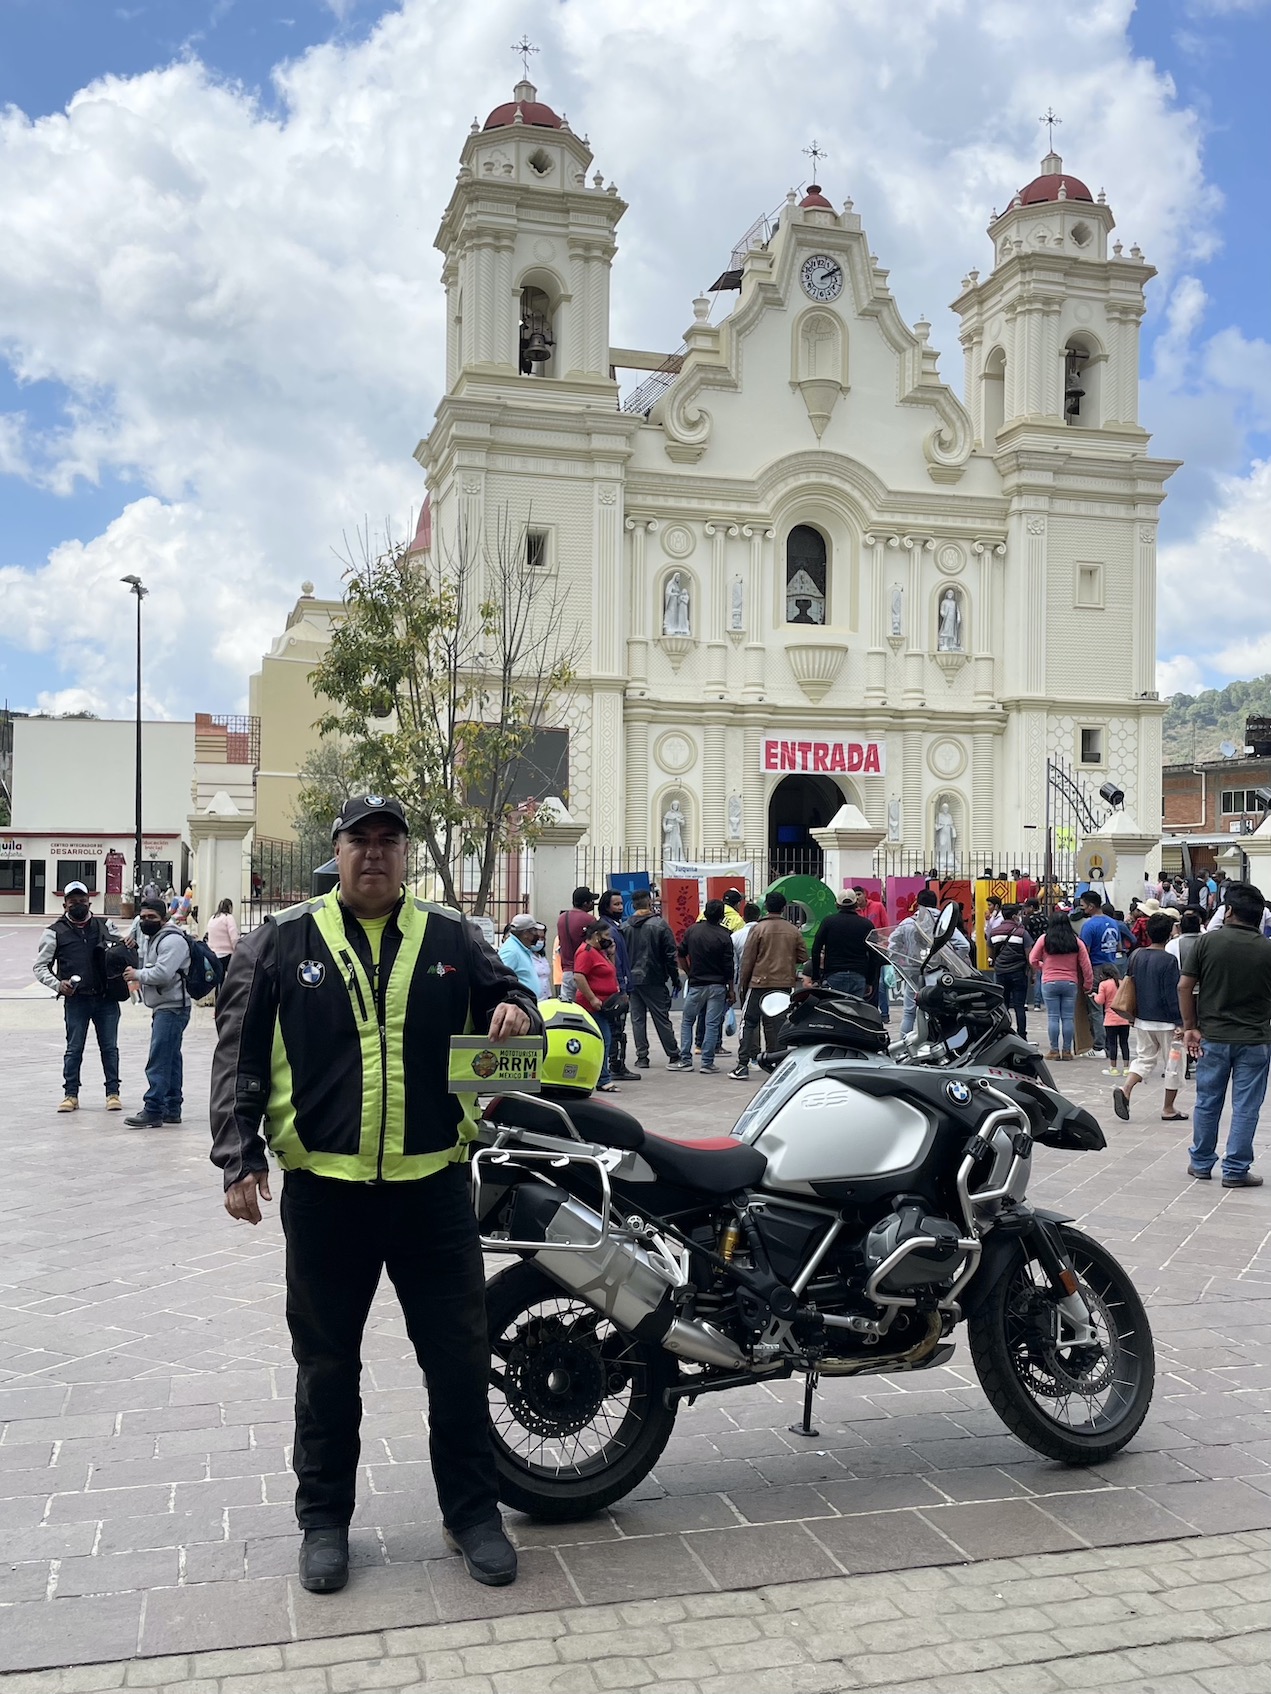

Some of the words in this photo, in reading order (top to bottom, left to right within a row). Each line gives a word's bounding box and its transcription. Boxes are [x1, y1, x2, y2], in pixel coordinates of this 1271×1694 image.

[765, 740, 880, 772] ENTRADA
[0, 840, 22, 851] uila
[499, 1057, 537, 1072] RRM
[801, 1090, 849, 1110] GS
